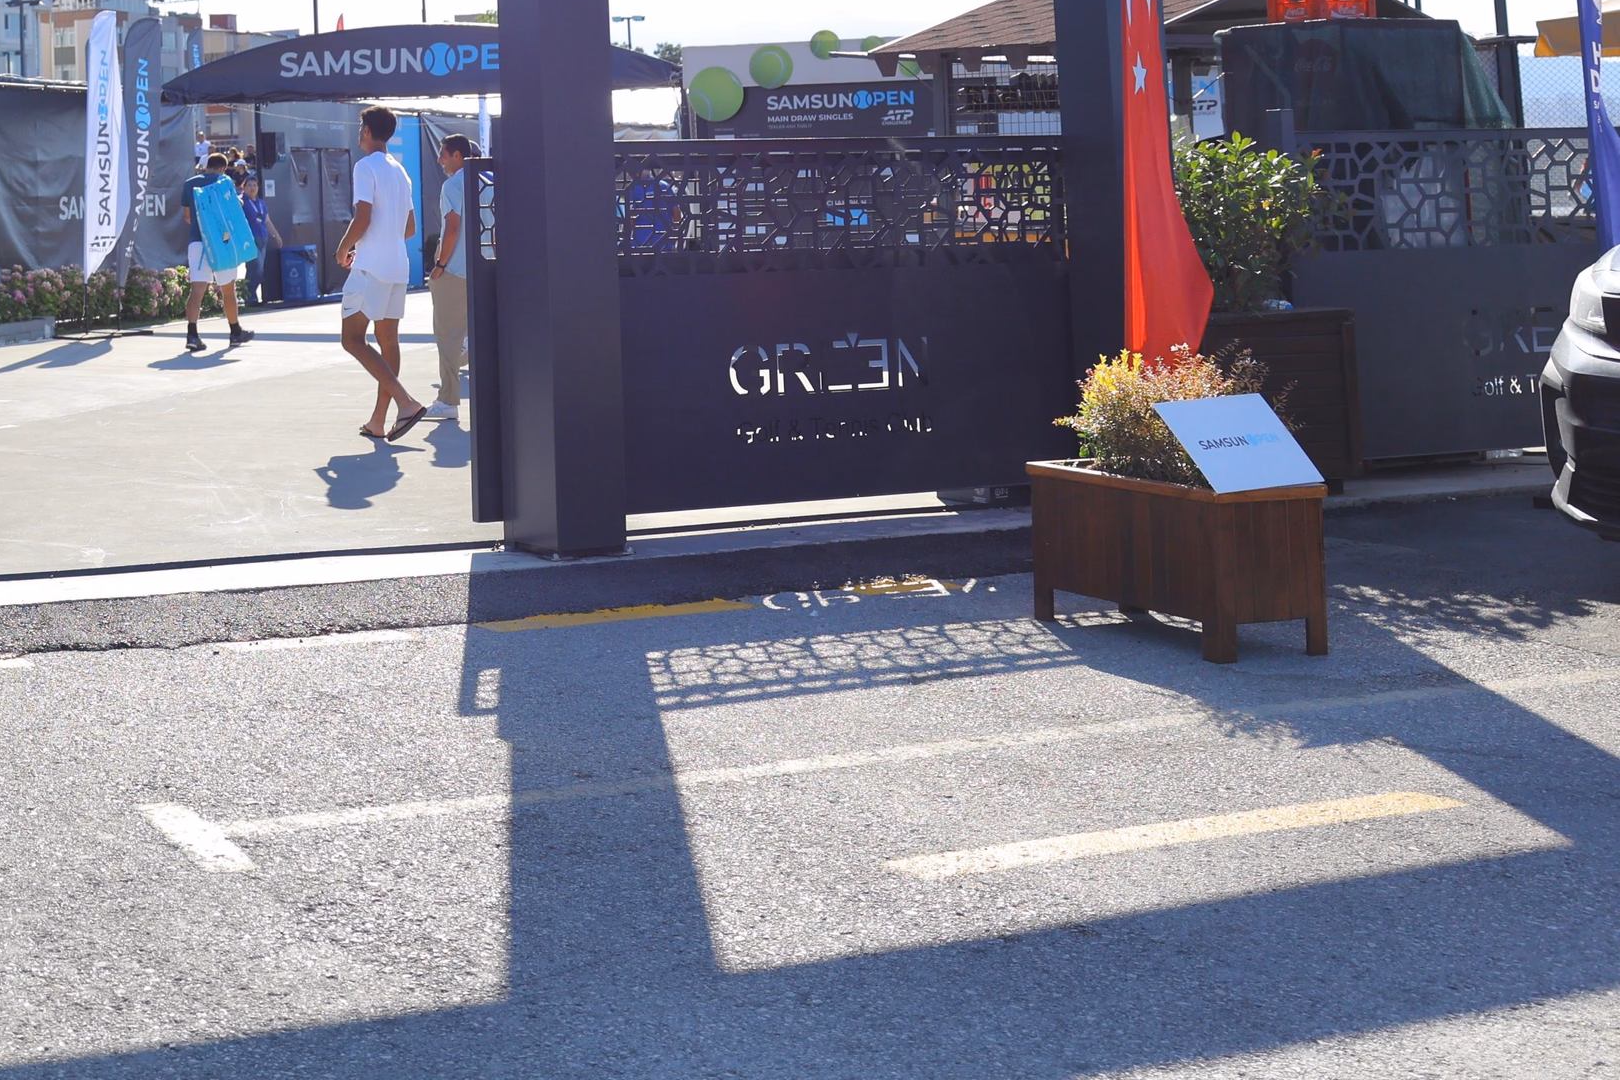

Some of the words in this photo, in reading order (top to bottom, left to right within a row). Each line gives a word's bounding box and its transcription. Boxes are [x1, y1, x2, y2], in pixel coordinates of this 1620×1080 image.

[279, 41, 499, 78] SAMSUNOPE
[767, 89, 915, 111] SAMSUNOPEN
[791, 114, 817, 122] DRAW
[818, 113, 853, 121] SINGLES
